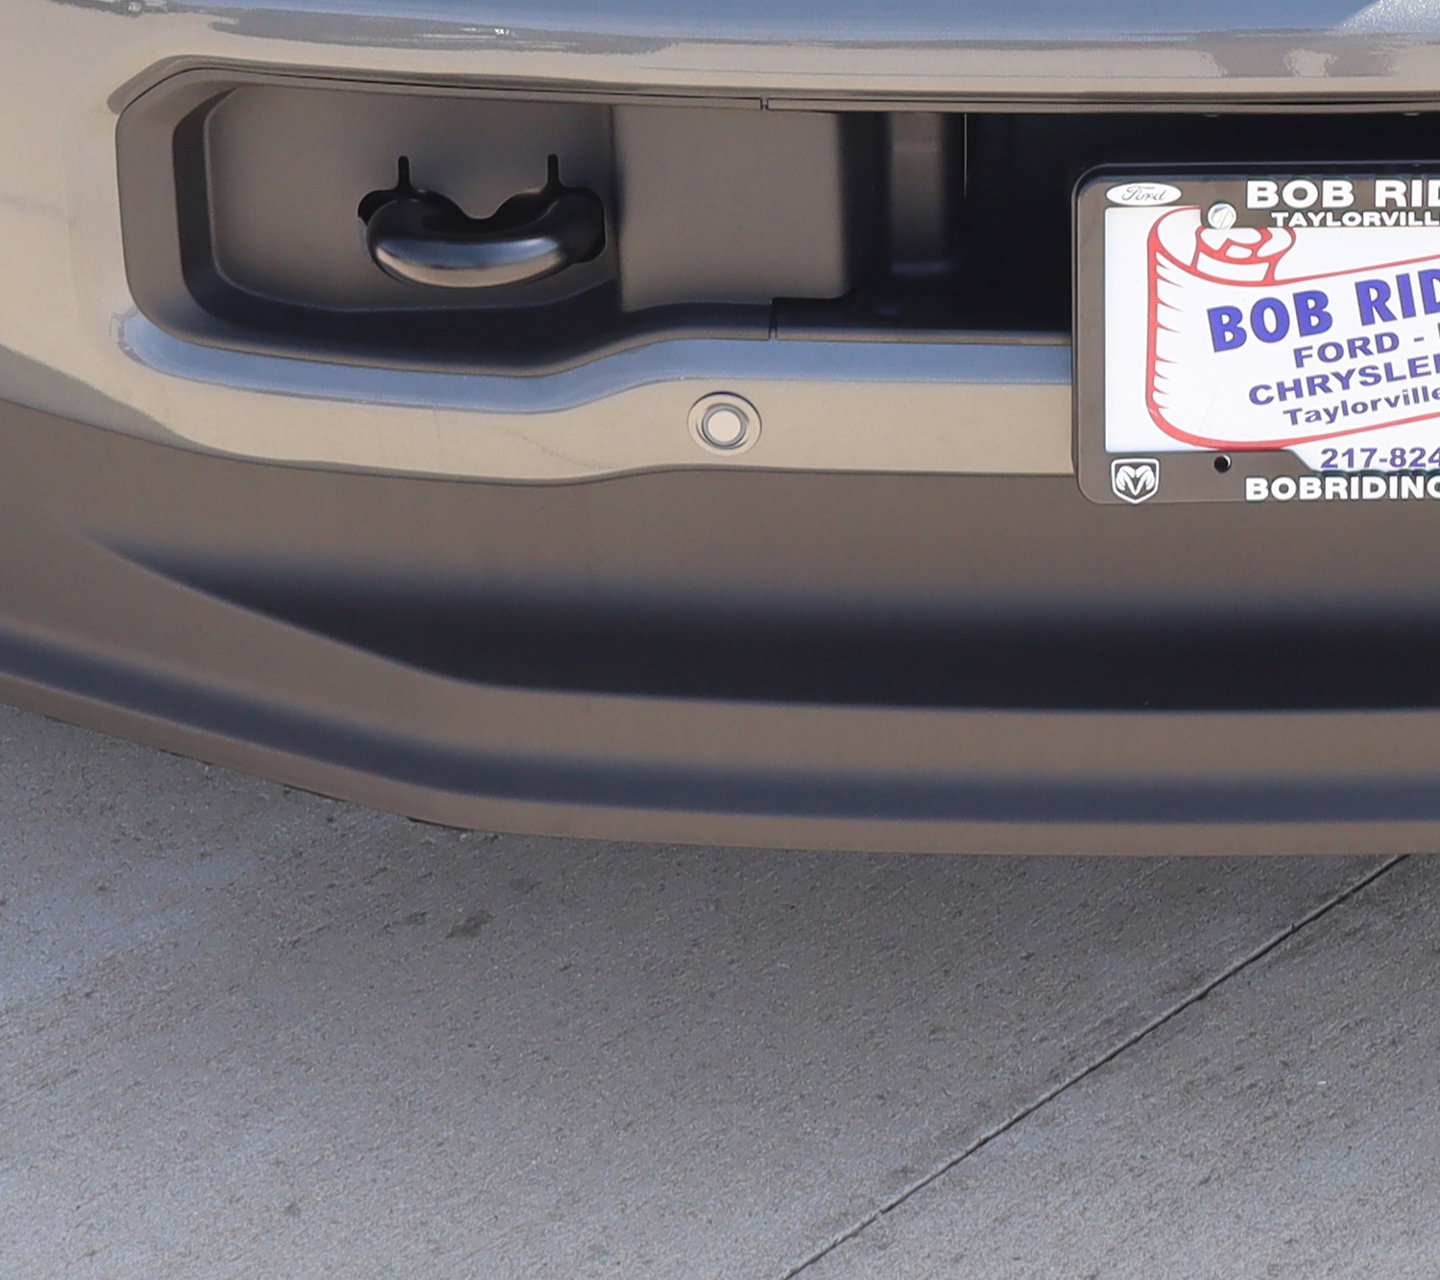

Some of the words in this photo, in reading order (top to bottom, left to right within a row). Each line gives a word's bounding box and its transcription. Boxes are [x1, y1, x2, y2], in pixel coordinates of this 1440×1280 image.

[1121, 184, 1166, 202] Ford
[1246, 179, 1355, 209] BOB
[1206, 289, 1333, 353] BOB
[1293, 331, 1400, 368] FORD
